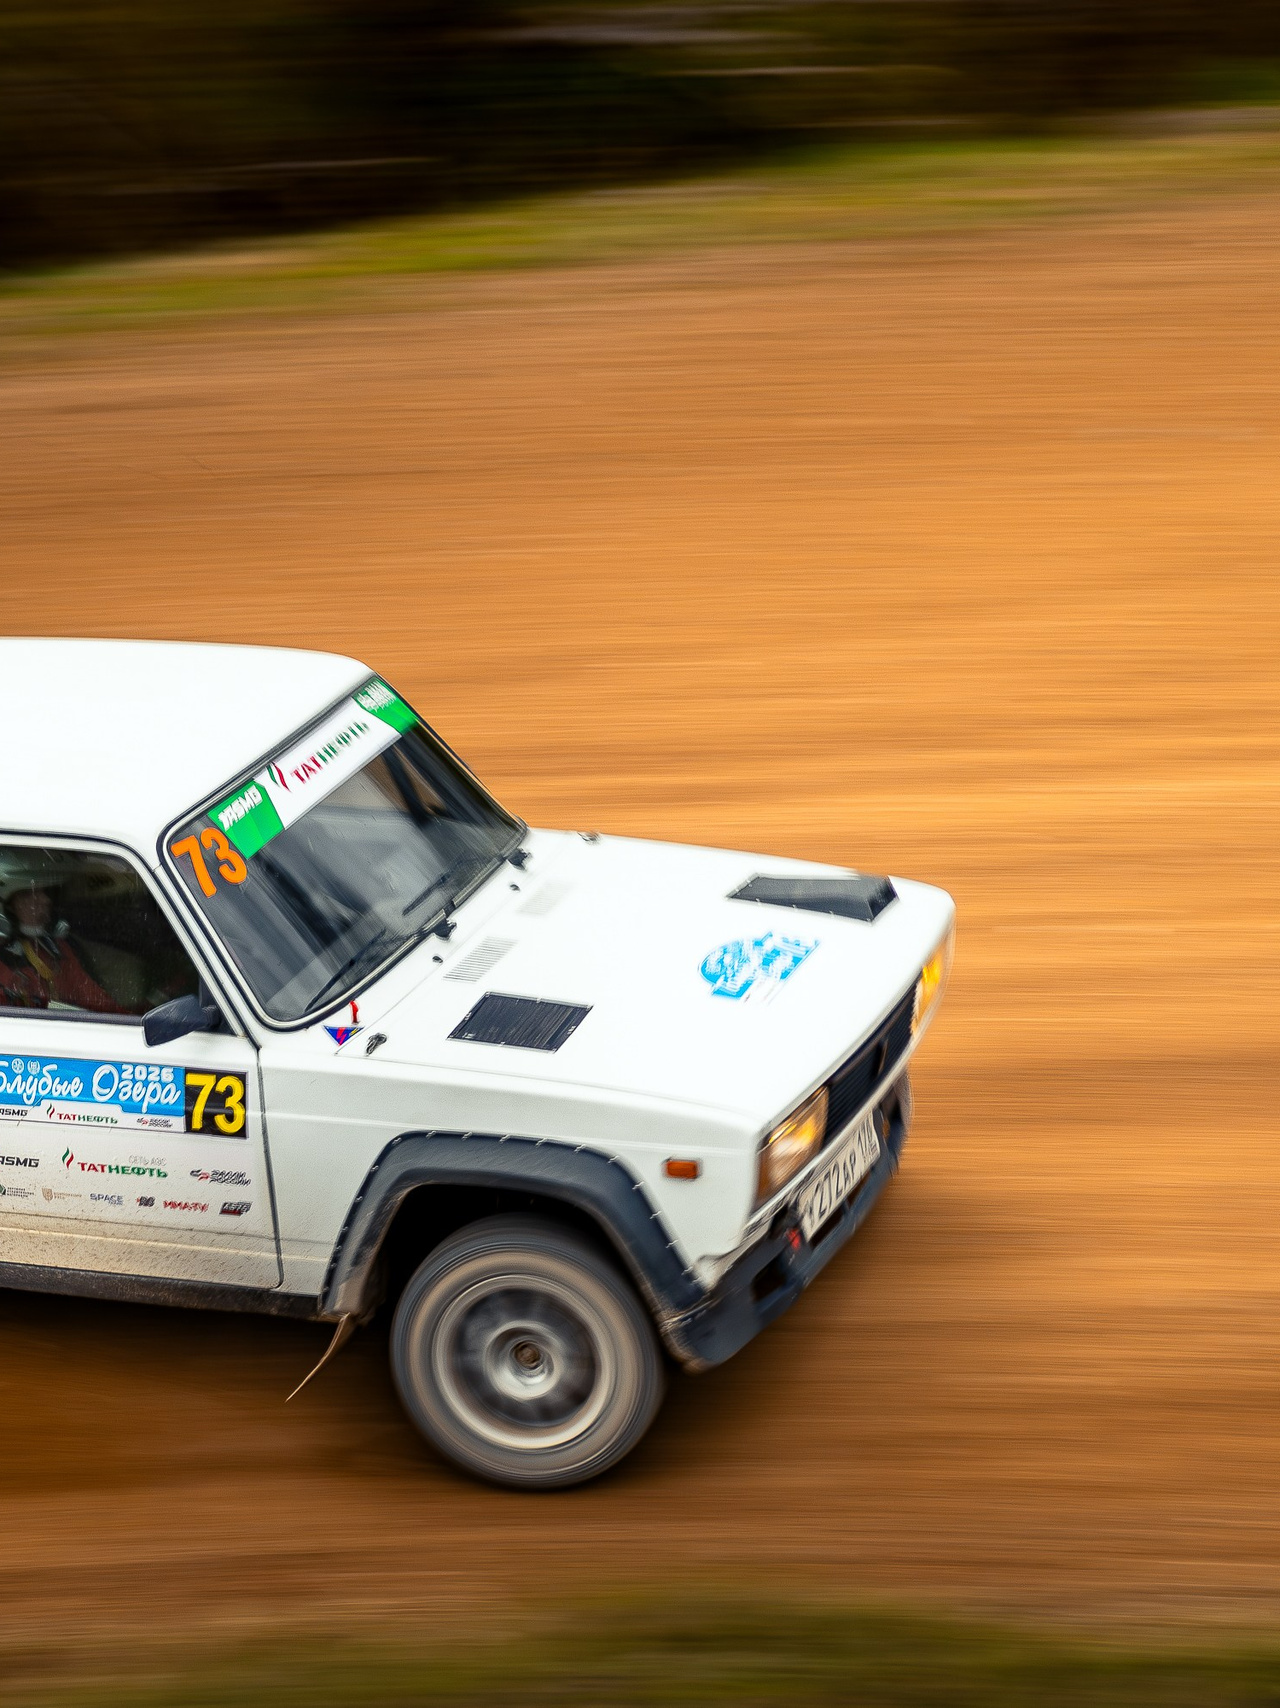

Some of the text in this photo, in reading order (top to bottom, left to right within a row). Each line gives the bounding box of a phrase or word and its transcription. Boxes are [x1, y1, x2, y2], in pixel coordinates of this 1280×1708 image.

[170, 826, 248, 898] 73
[57, 1112, 118, 1125] ТАТНЕФТЬ
[185, 1072, 246, 1136] 73
[77, 1161, 168, 1178] ТАТНЕФТЬ
